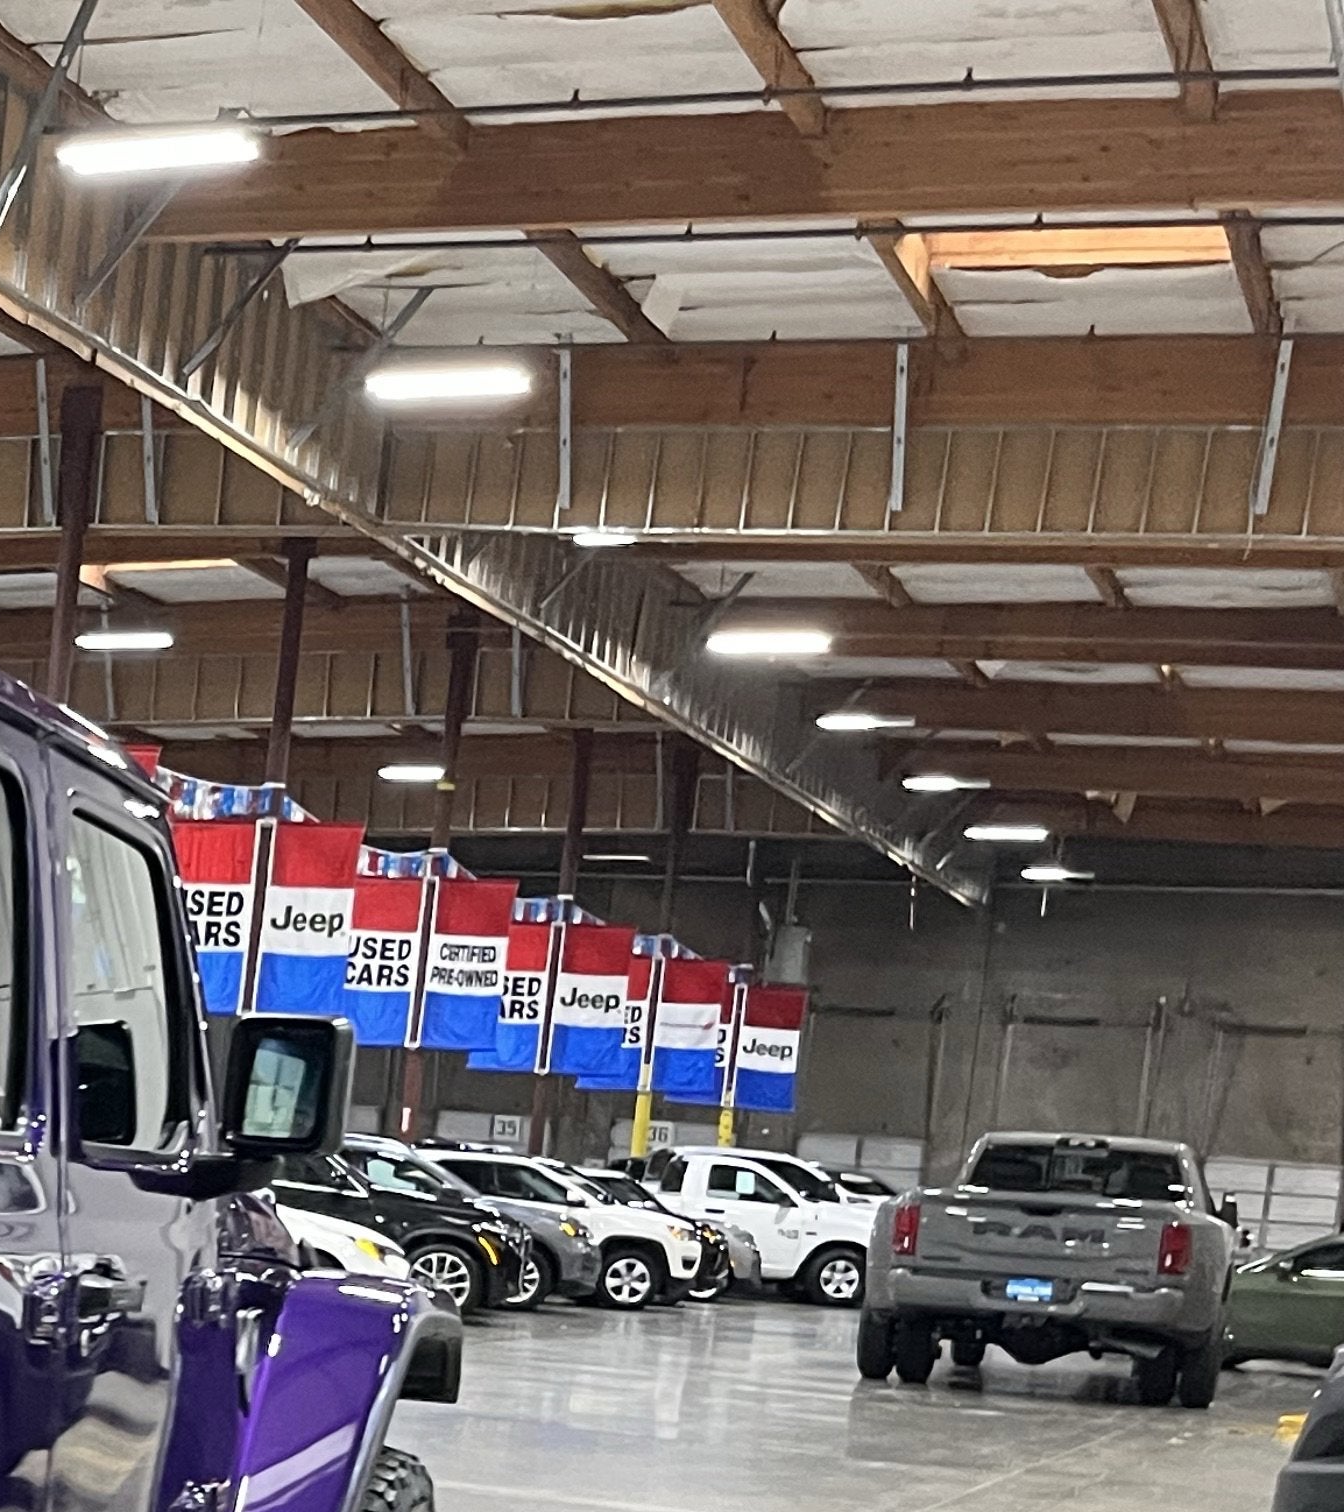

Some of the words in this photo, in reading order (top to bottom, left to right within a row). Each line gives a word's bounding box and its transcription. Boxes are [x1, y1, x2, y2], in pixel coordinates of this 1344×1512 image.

[185, 890, 244, 916] SED
[270, 905, 344, 938] Jeep
[348, 936, 412, 961] USED
[439, 943, 497, 963] CERTIFIED
[346, 961, 410, 986] CARS
[429, 966, 498, 987] PRE-OWNED
[561, 987, 620, 1013] Jeep
[743, 1038, 793, 1061] Jeep
[972, 1220, 1105, 1248] RAM
